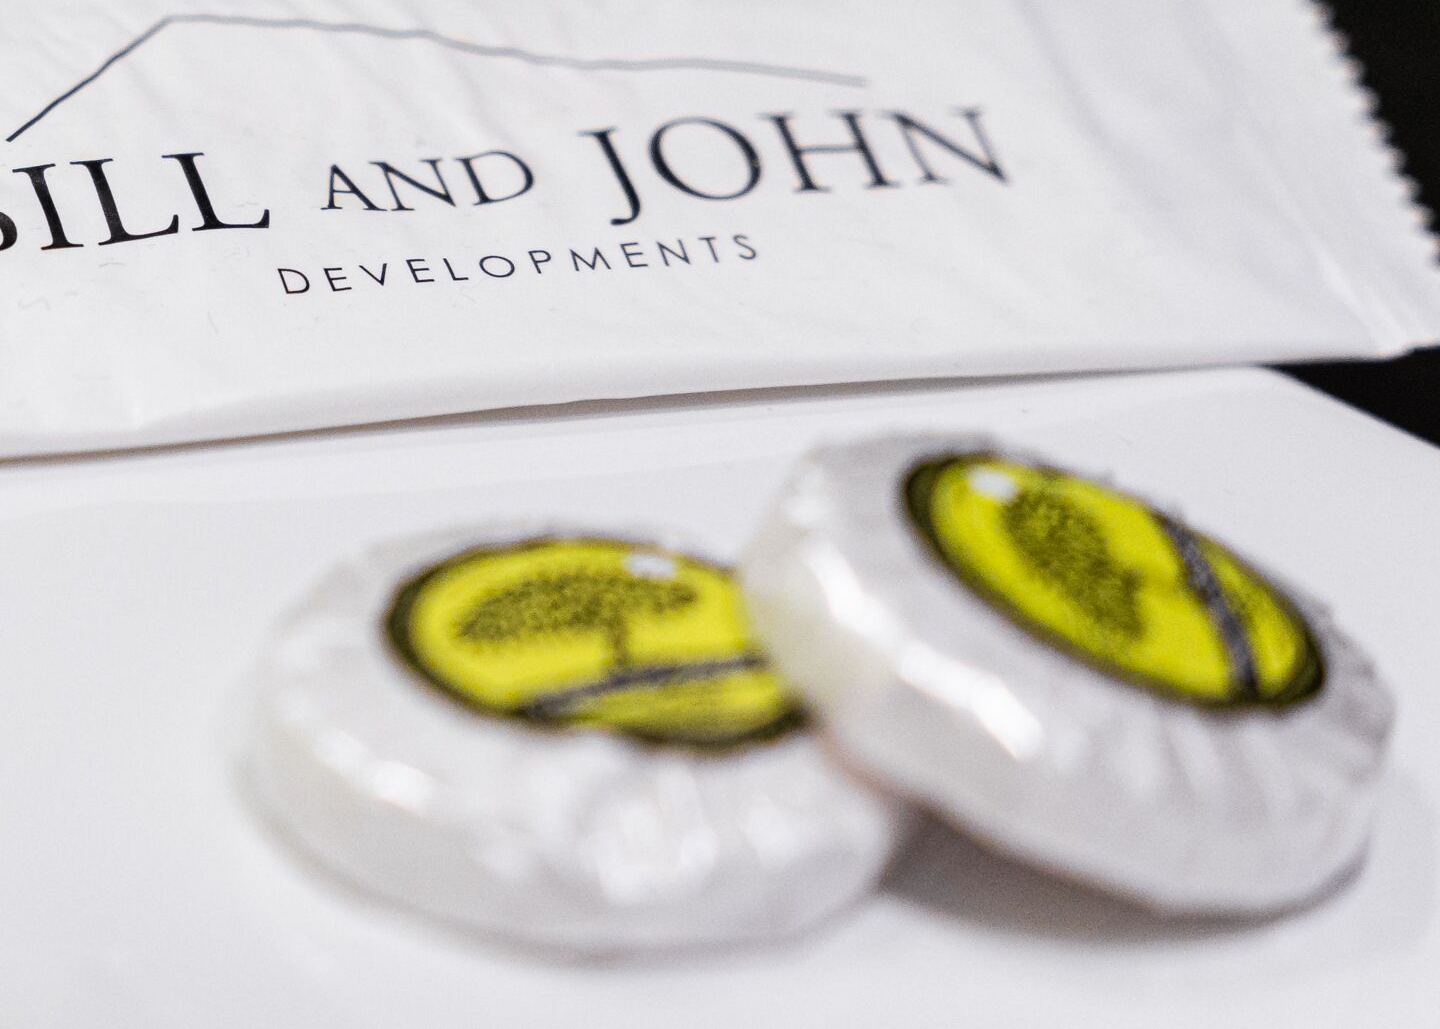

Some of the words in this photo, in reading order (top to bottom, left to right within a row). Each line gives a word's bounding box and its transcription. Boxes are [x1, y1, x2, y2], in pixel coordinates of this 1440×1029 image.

[321, 151, 535, 211] AND
[581, 106, 1012, 226] JOHN
[277, 233, 758, 295] DEVELOPMENTS
